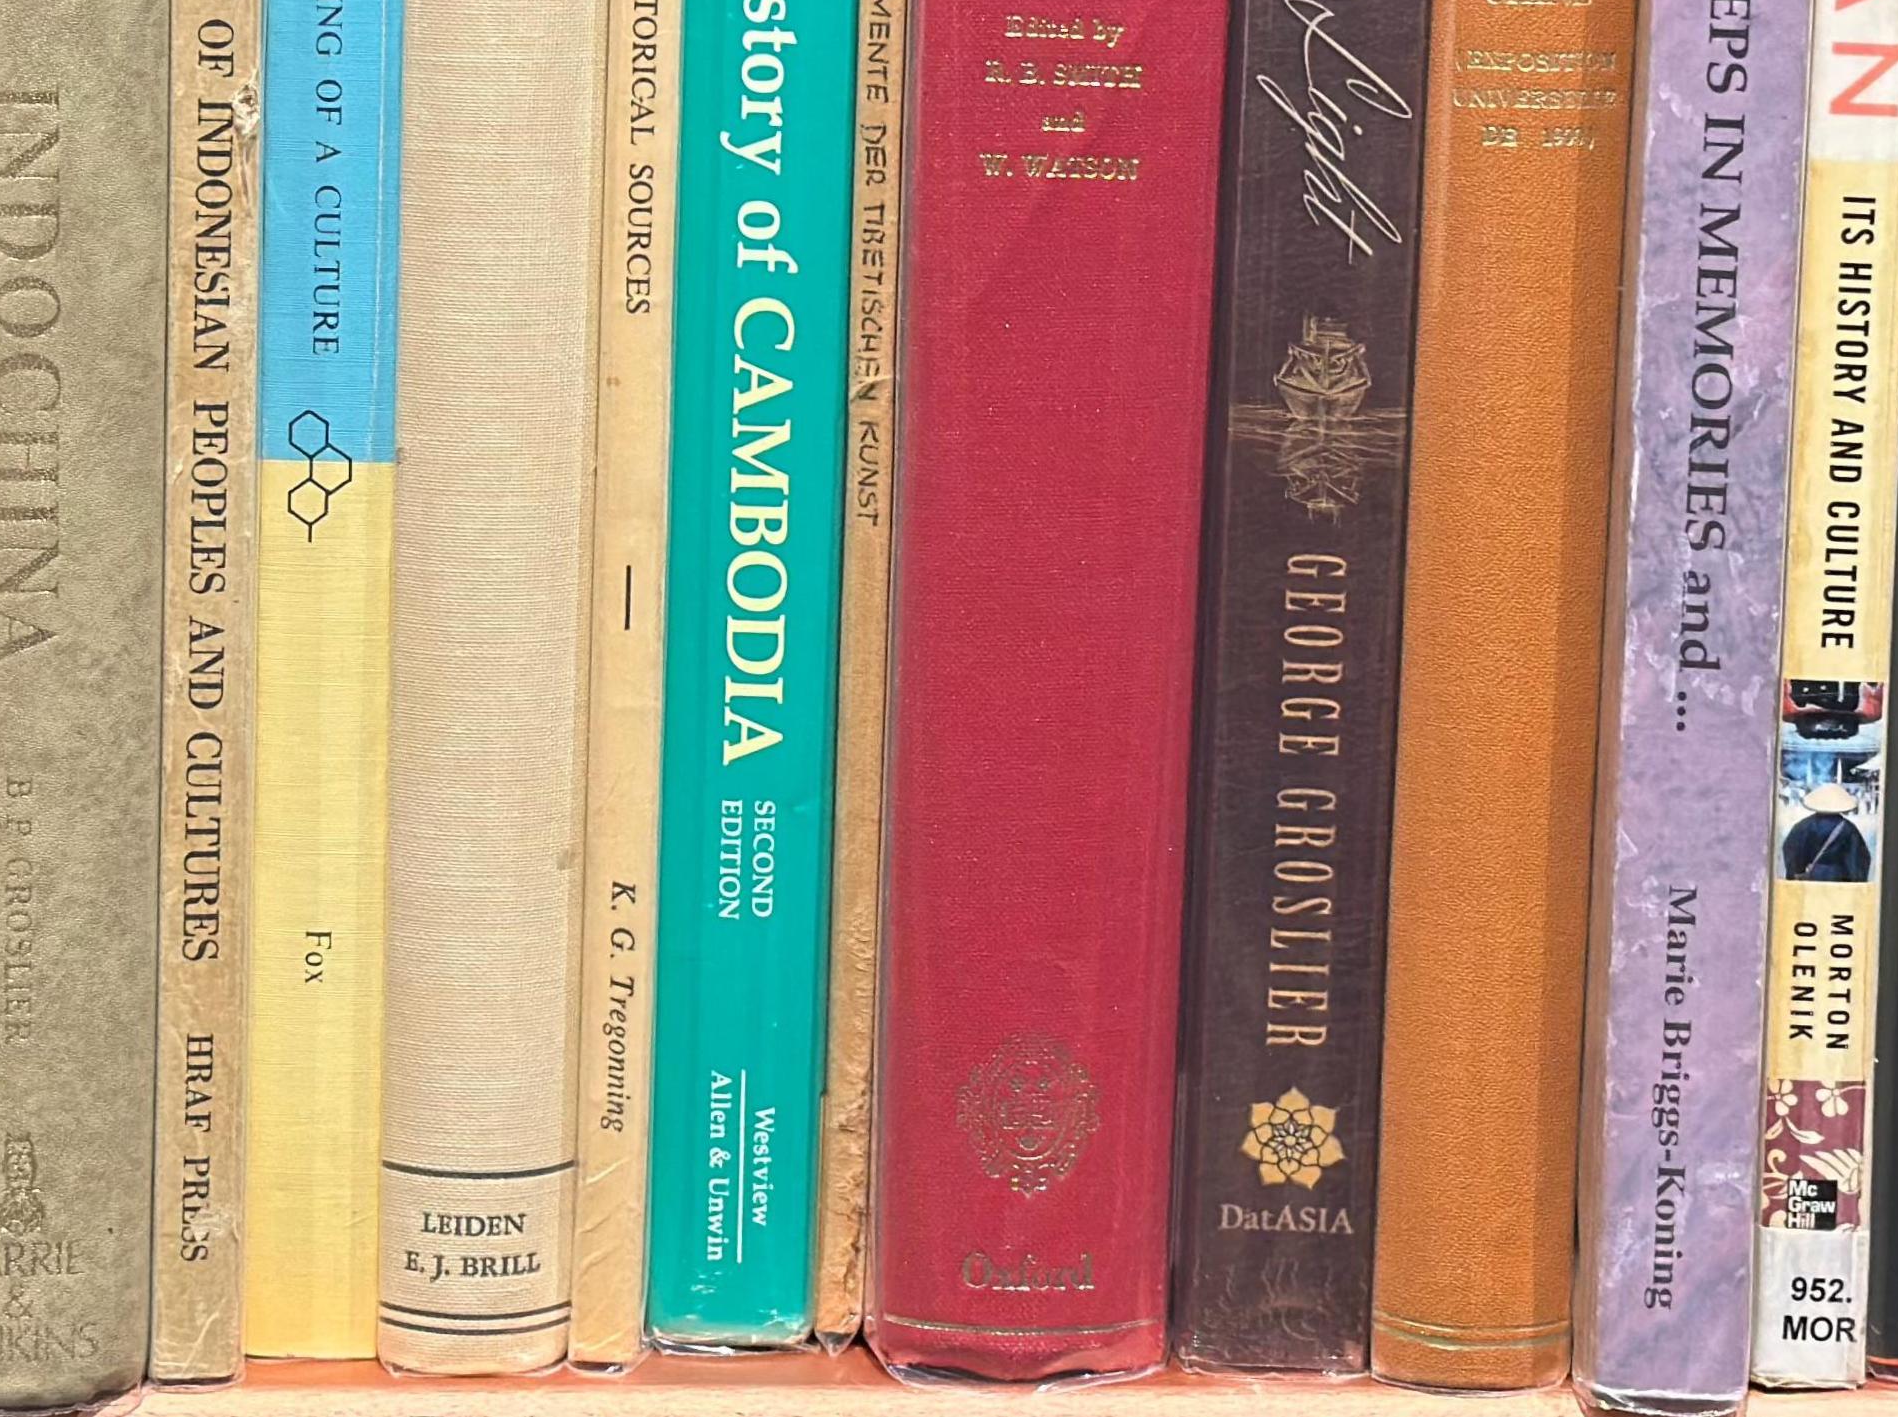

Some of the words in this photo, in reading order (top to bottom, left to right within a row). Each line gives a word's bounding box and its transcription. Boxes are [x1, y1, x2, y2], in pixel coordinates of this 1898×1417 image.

[196, 20, 236, 78] OF
[315, 80, 343, 127] OF
[1701, 113, 1746, 184] IN
[192, 99, 234, 373] INDONESIAN
[312, 185, 342, 356] CULTURE
[625, 164, 653, 315] SOURCES
[735, 200, 799, 274] of
[1841, 196, 1876, 247] ITS
[1683, 202, 1741, 552] MEMORIES
[1834, 263, 1872, 406] HISTORY
[188, 400, 230, 596] PEOPLES
[856, 420, 880, 526] KUNST
[1829, 417, 1866, 483] AND
[722, 296, 795, 766] CAMBODIA
[1821, 501, 1861, 650] CULTURE
[187, 617, 225, 710] AND
[1281, 552, 1347, 759] GEORGE
[1678, 570, 1721, 672] and
[182, 730, 223, 963] CULTURES
[717, 799, 743, 921] EDITION
[751, 799, 775, 919] SECOND
[304, 931, 332, 985] Fox
[1265, 788, 1339, 1051] GROSLIER
[1663, 884, 1697, 1007] Marie
[1788, 921, 1819, 1040] OLENIK
[1825, 914, 1855, 1050] MORTON
[185, 1034, 214, 1133] HRAF
[1644, 1020, 1693, 1310] Briggs-Koning
[1788, 1196, 1836, 1213] Graw
[1789, 1180, 1818, 1196] Mc
[422, 1212, 525, 1237] LEIDEN
[459, 1252, 540, 1279] BRILL
[1219, 1202, 1354, 1235] DatASIA
[1788, 1213, 1815, 1229] Hill
[1782, 1316, 1857, 1344] MOR
[1791, 1277, 1852, 1304] 952.
